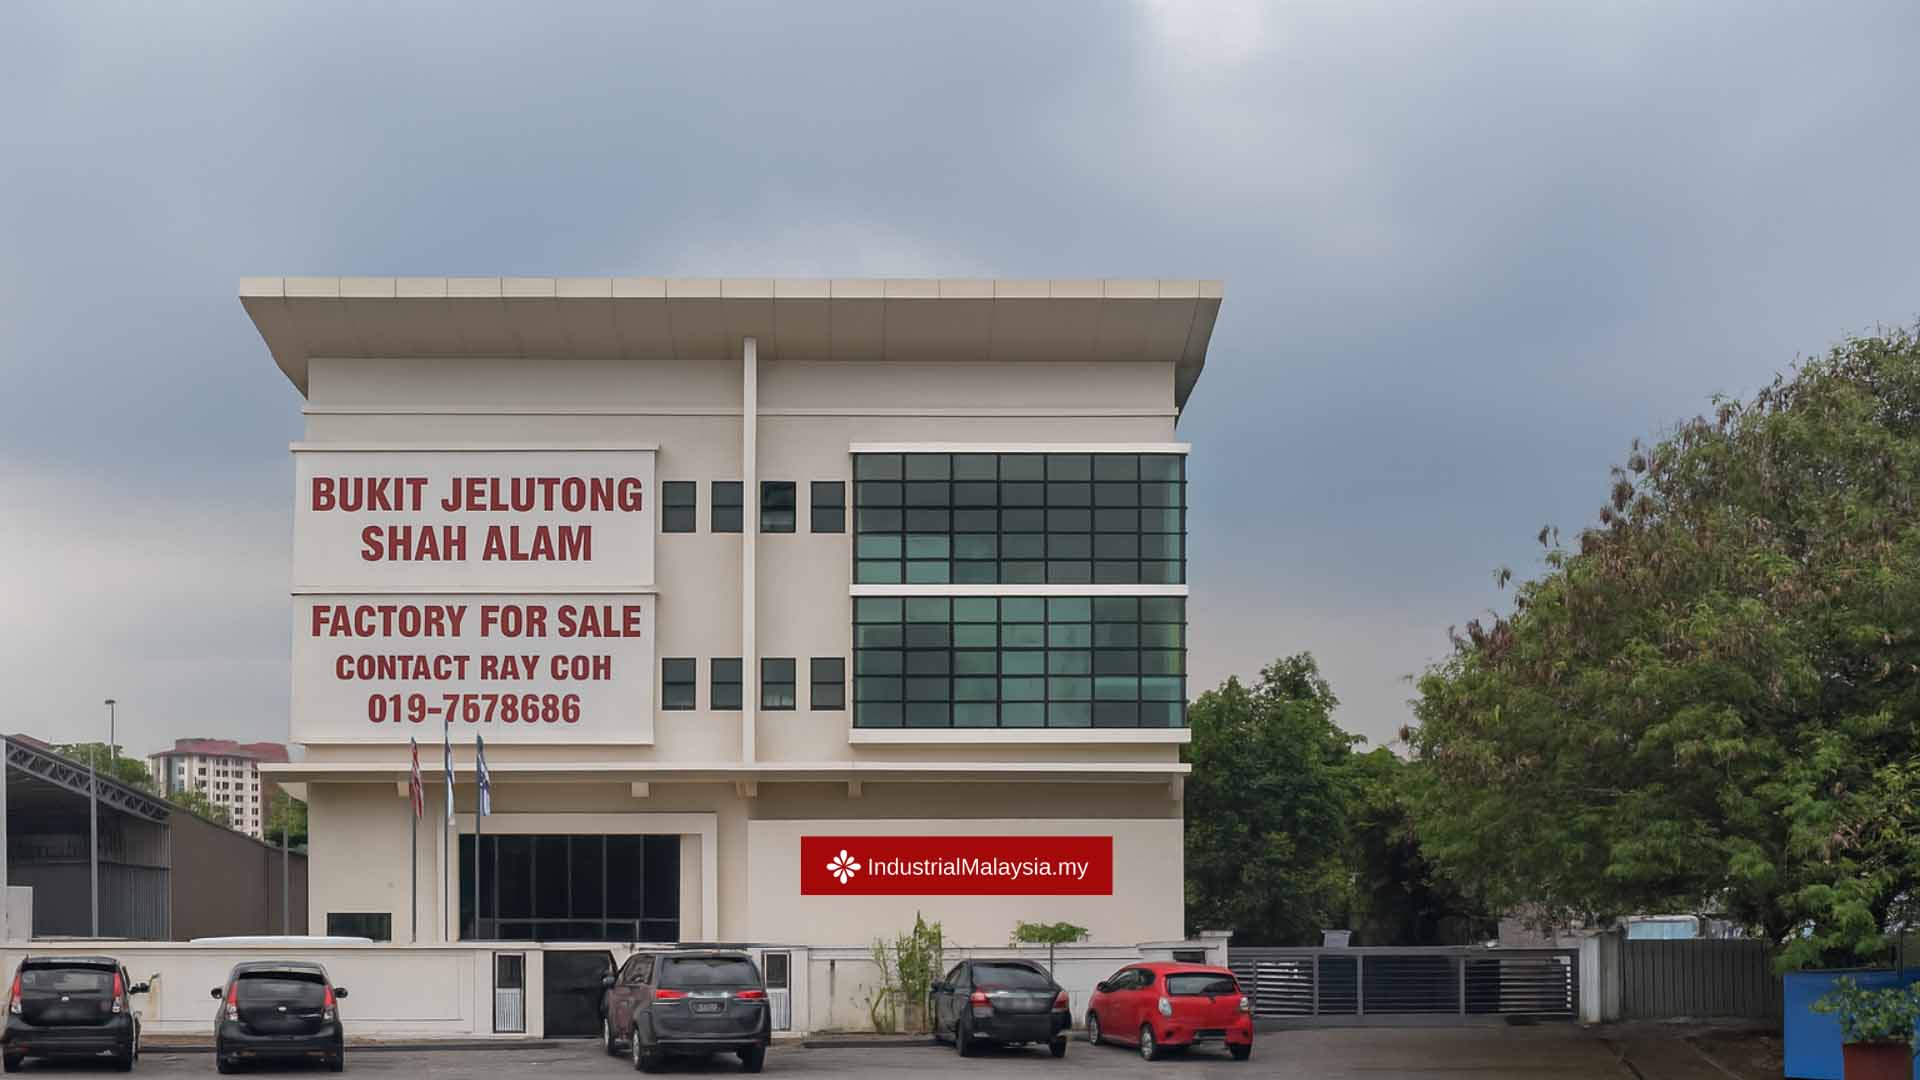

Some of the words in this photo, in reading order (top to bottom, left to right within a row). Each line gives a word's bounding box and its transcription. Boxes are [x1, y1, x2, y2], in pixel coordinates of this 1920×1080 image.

[312, 477, 429, 512] BUKIT
[441, 477, 643, 512] JELUTONG
[361, 525, 467, 561] SHAH
[482, 525, 593, 561] ALAM
[311, 604, 467, 638] FACTORY
[480, 605, 547, 638] FOR
[558, 604, 641, 638] SALE
[335, 655, 470, 681] CONTACT
[480, 655, 540, 681] RAY
